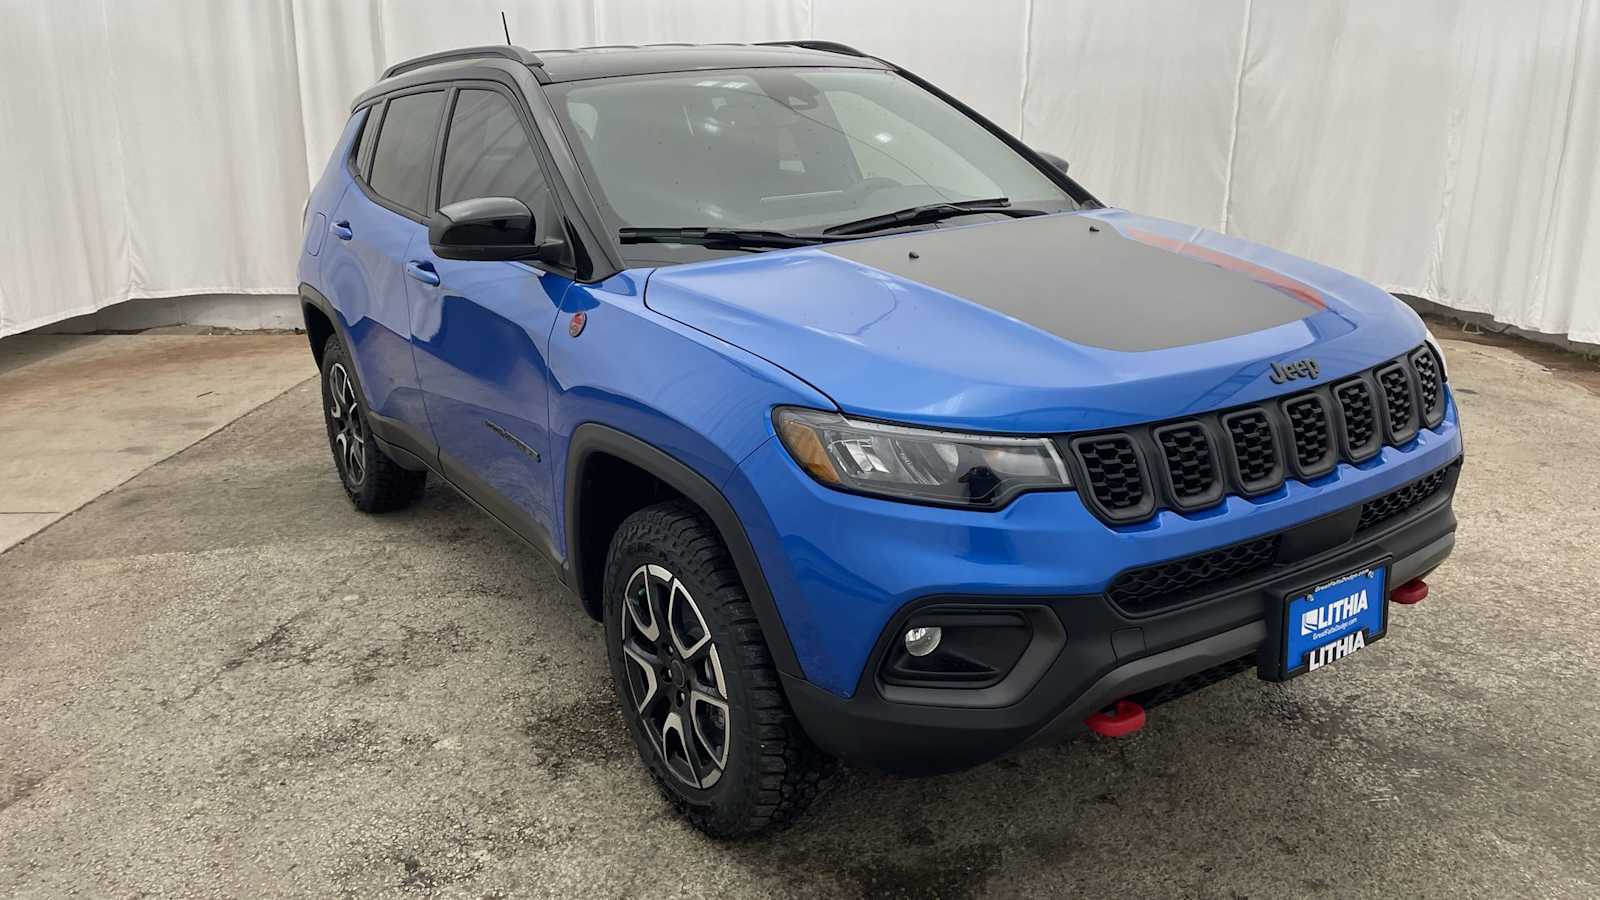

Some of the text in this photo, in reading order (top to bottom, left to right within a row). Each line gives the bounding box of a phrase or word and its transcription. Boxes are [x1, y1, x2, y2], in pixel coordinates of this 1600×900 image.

[1269, 359, 1319, 384] Jeep
[1318, 589, 1368, 630] LITHIA
[1309, 630, 1365, 672] LITHIA
